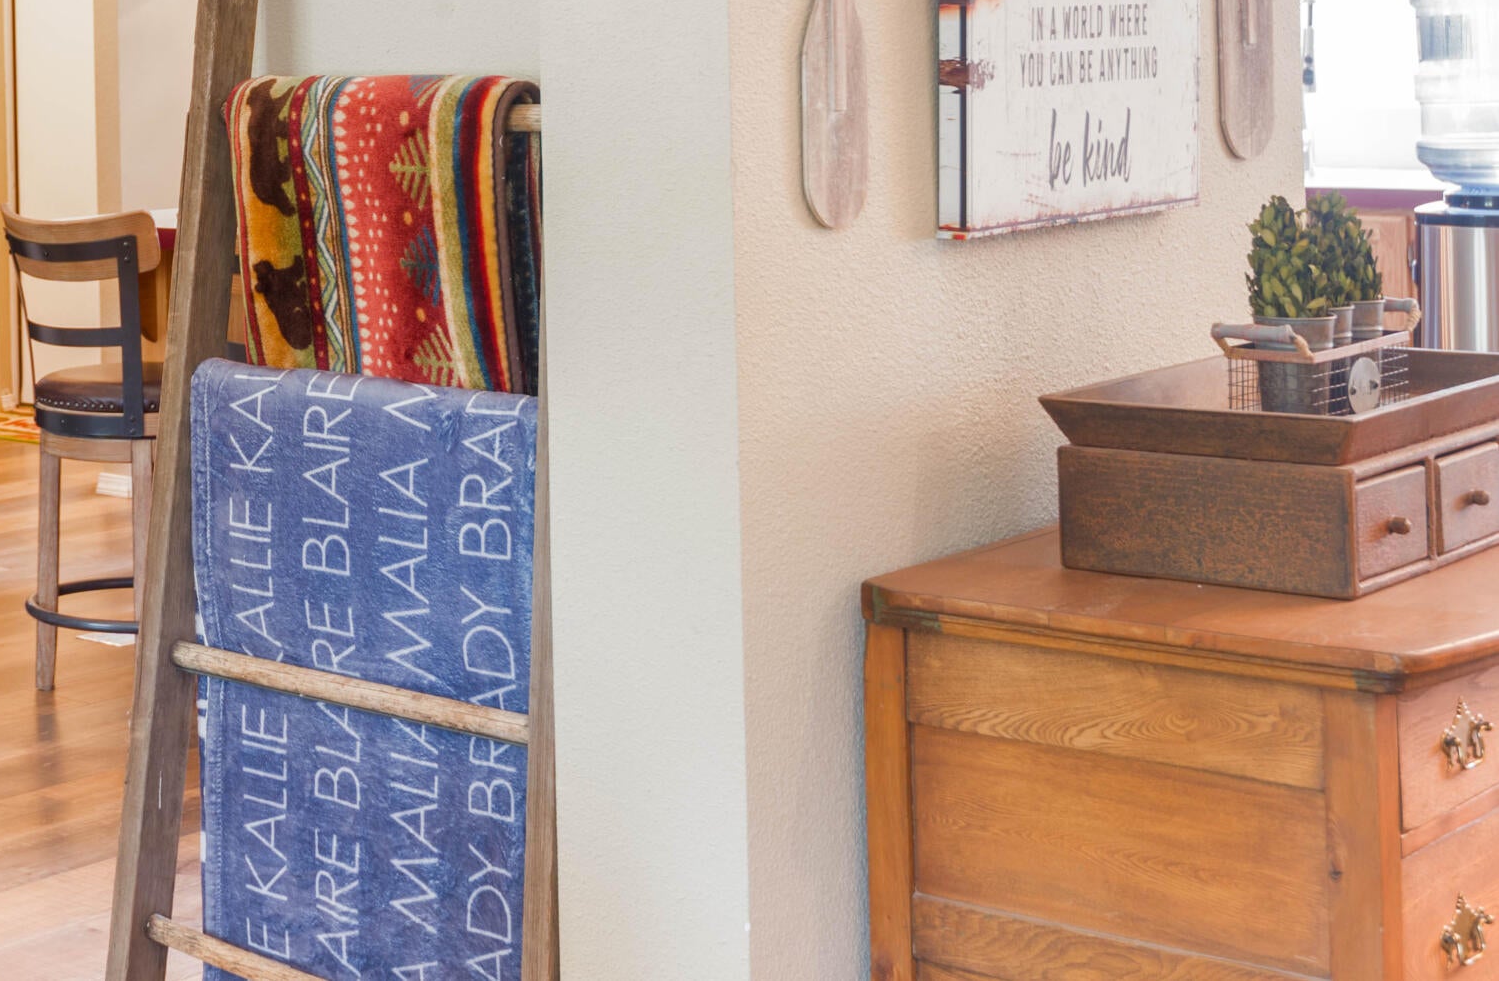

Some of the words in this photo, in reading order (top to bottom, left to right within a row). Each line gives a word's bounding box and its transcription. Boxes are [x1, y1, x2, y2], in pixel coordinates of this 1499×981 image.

[1020, 52, 1043, 88] YOU
[1050, 50, 1074, 86] CAN
[1079, 49, 1093, 83] BE
[1099, 46, 1158, 82] ANYTHING
[1031, 7, 1044, 41] IN
[1050, 6, 1057, 40] A
[1062, 4, 1103, 39] WORLD
[1109, 3, 1148, 37] WHERE
[1049, 108, 1072, 191] be
[1083, 107, 1131, 187] kind
[302, 372, 364, 576] BLAIRE
[229, 497, 284, 661] ALLIE
[378, 458, 438, 685] MALIA
[242, 704, 288, 902] KALLIE
